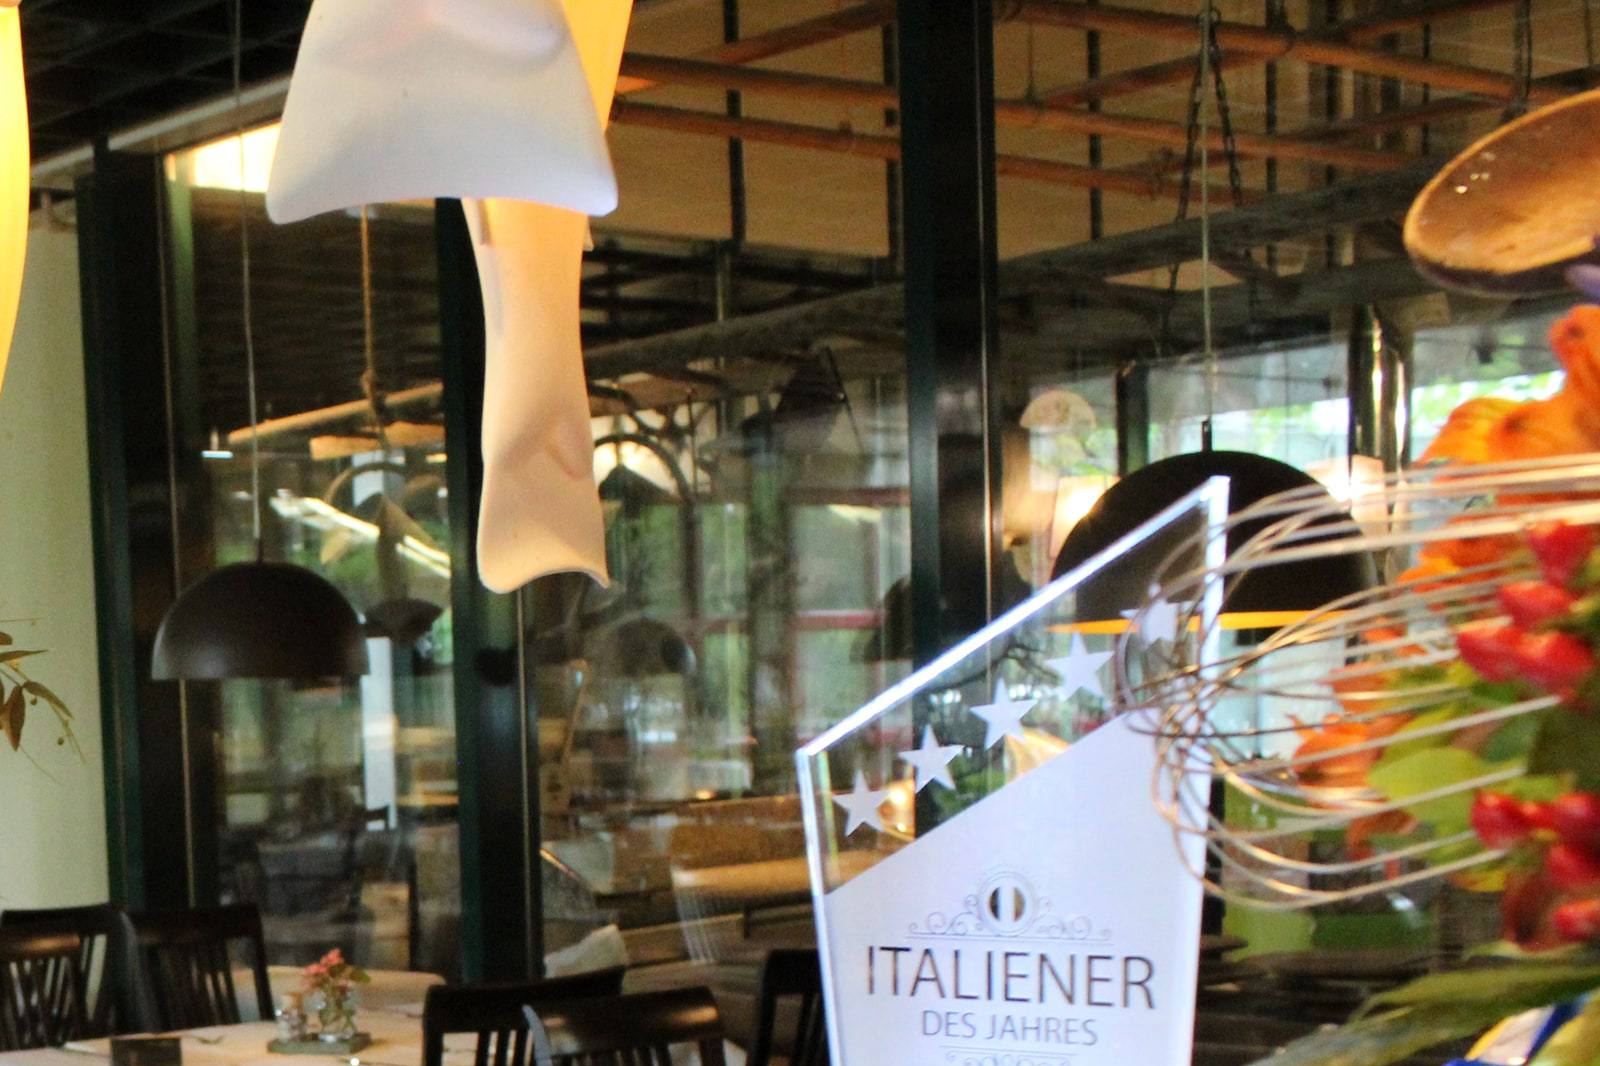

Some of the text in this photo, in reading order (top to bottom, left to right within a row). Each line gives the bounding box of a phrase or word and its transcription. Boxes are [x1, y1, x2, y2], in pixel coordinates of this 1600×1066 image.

[866, 945, 1156, 1009] ITALIENER
[922, 1009, 1099, 1046] DES JAHRES
